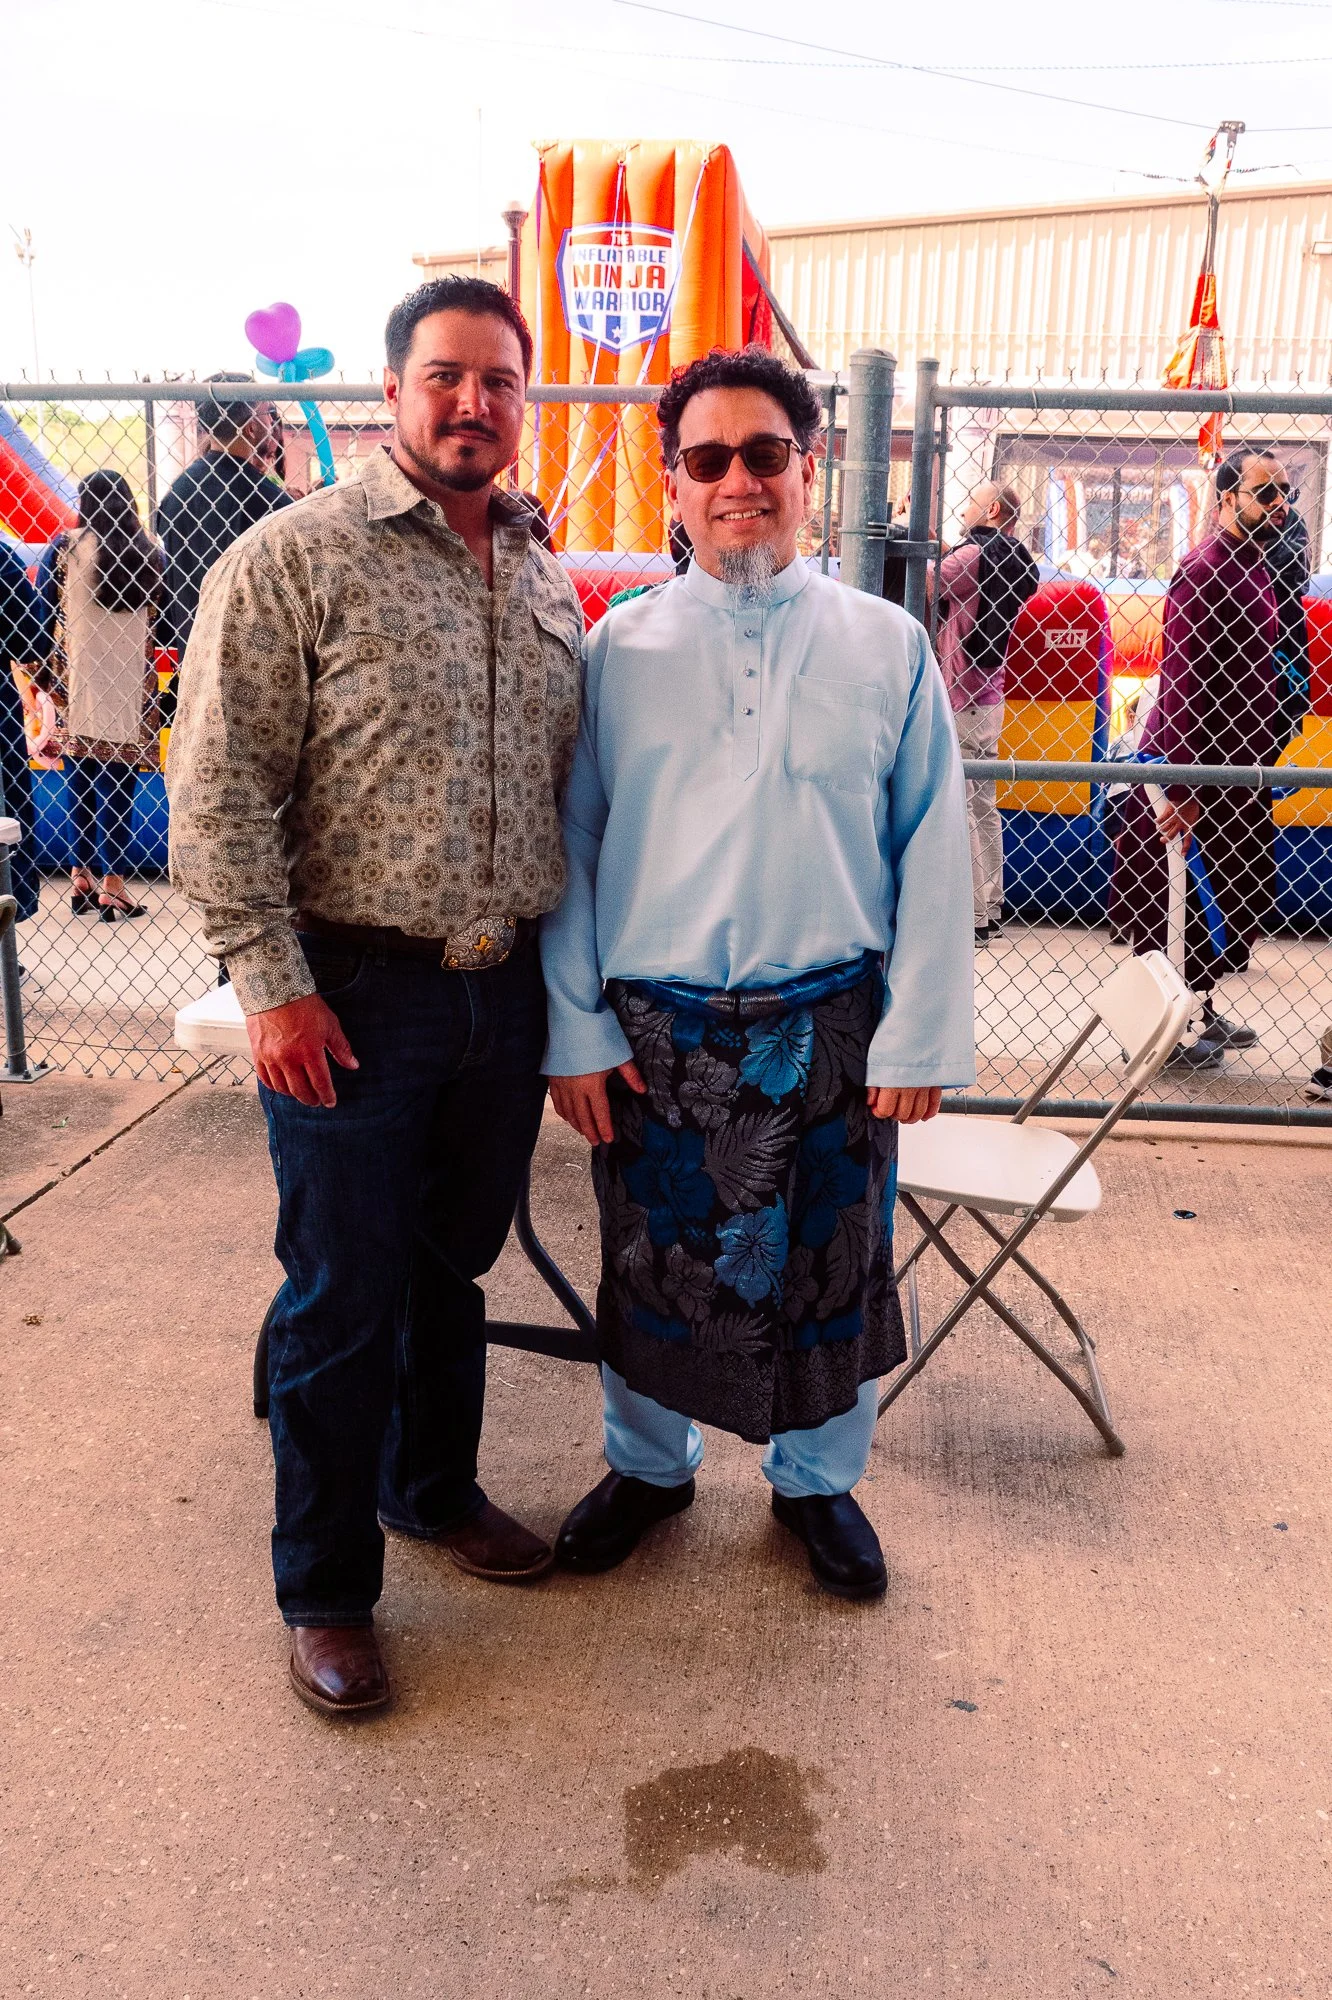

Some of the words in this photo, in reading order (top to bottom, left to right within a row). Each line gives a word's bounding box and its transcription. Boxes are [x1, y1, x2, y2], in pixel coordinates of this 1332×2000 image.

[573, 264, 666, 289] NINJA
[574, 290, 666, 312] WARRIOR
[1050, 631, 1085, 646] EXIT
